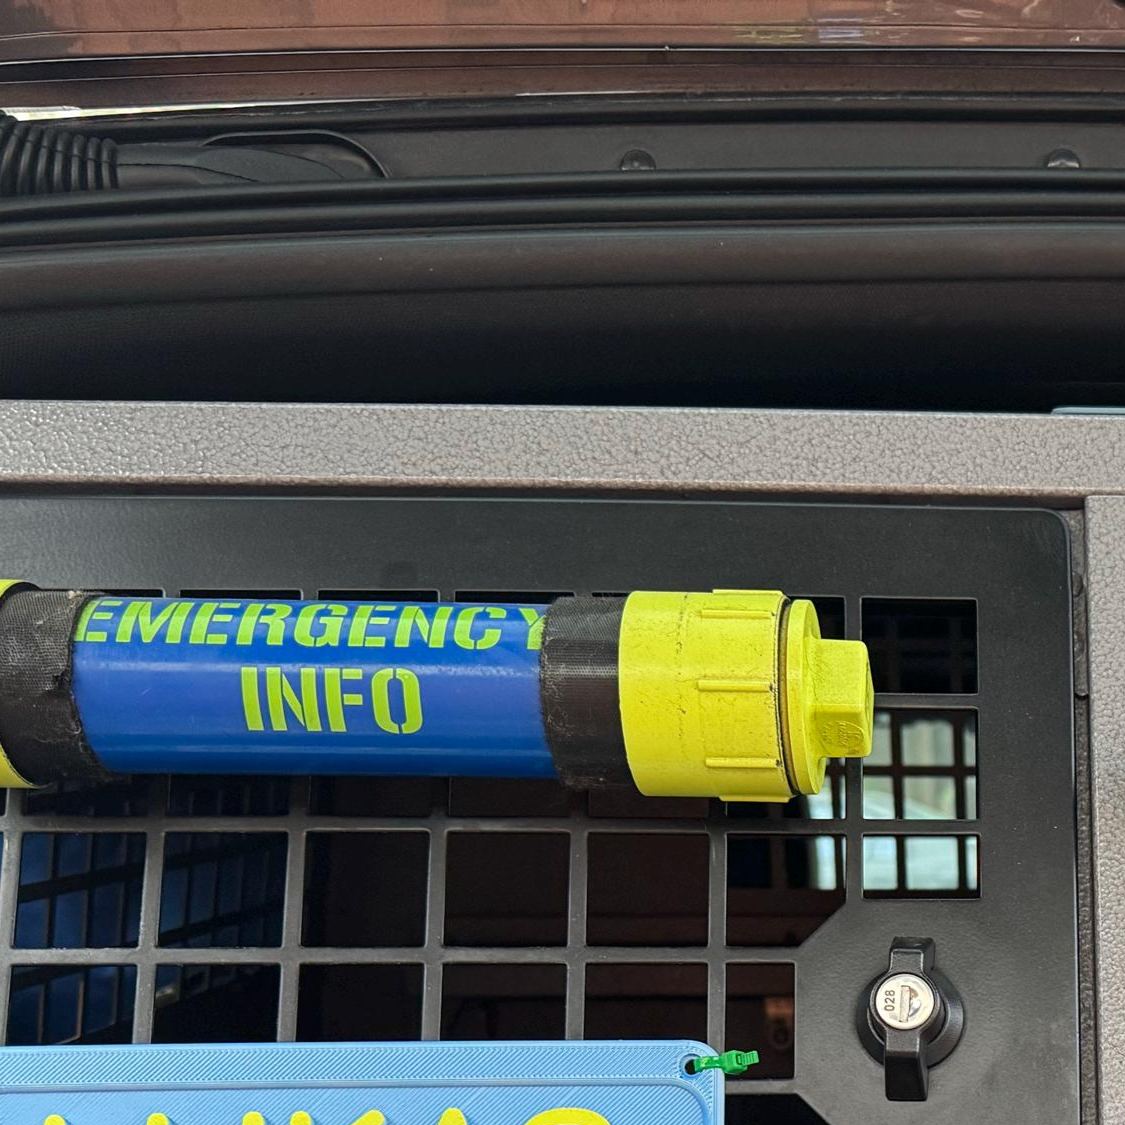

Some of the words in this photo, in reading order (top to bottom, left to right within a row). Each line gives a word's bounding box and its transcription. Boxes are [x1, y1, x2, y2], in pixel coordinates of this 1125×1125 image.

[74, 600, 544, 650] EMERGENCY
[241, 666, 424, 735] INFO
[883, 989, 896, 1012] 028
